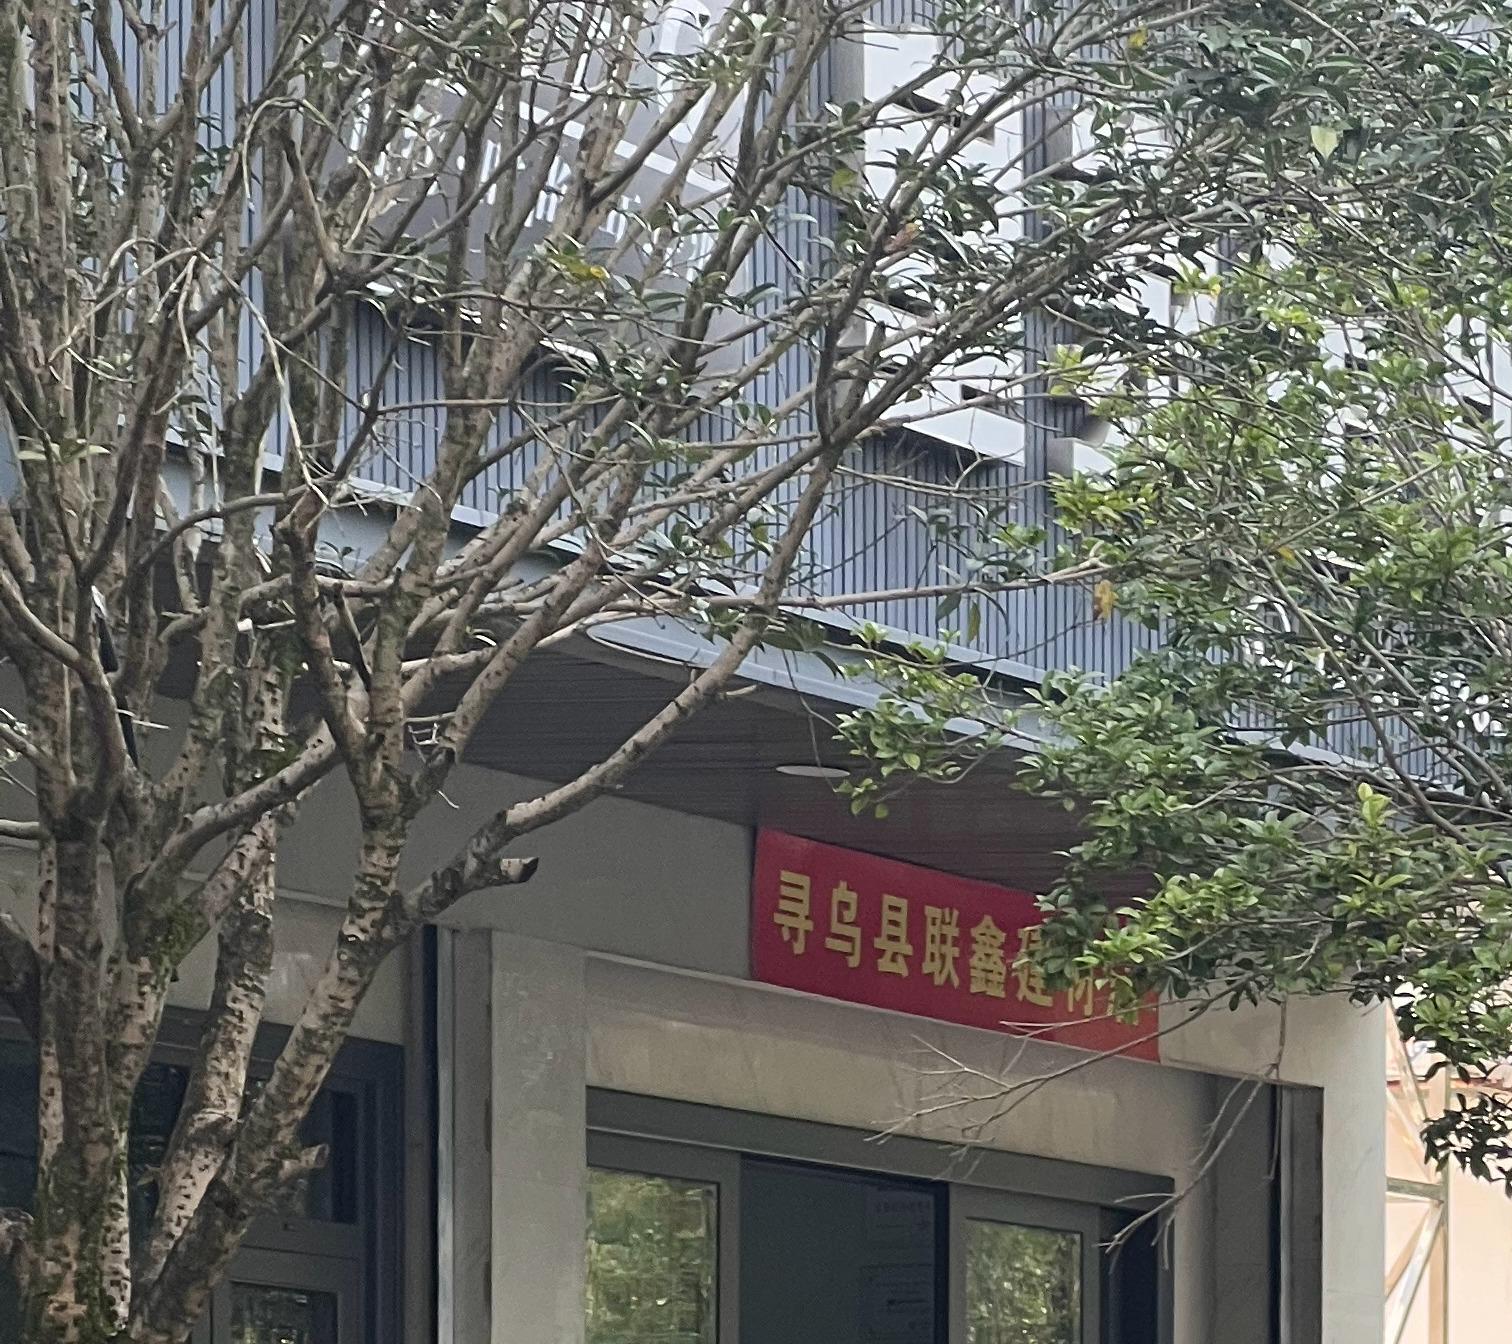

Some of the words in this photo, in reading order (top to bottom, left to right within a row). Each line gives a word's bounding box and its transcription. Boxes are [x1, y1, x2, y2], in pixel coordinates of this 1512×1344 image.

[773, 870, 1140, 1026] 寻乌县联鑫建
